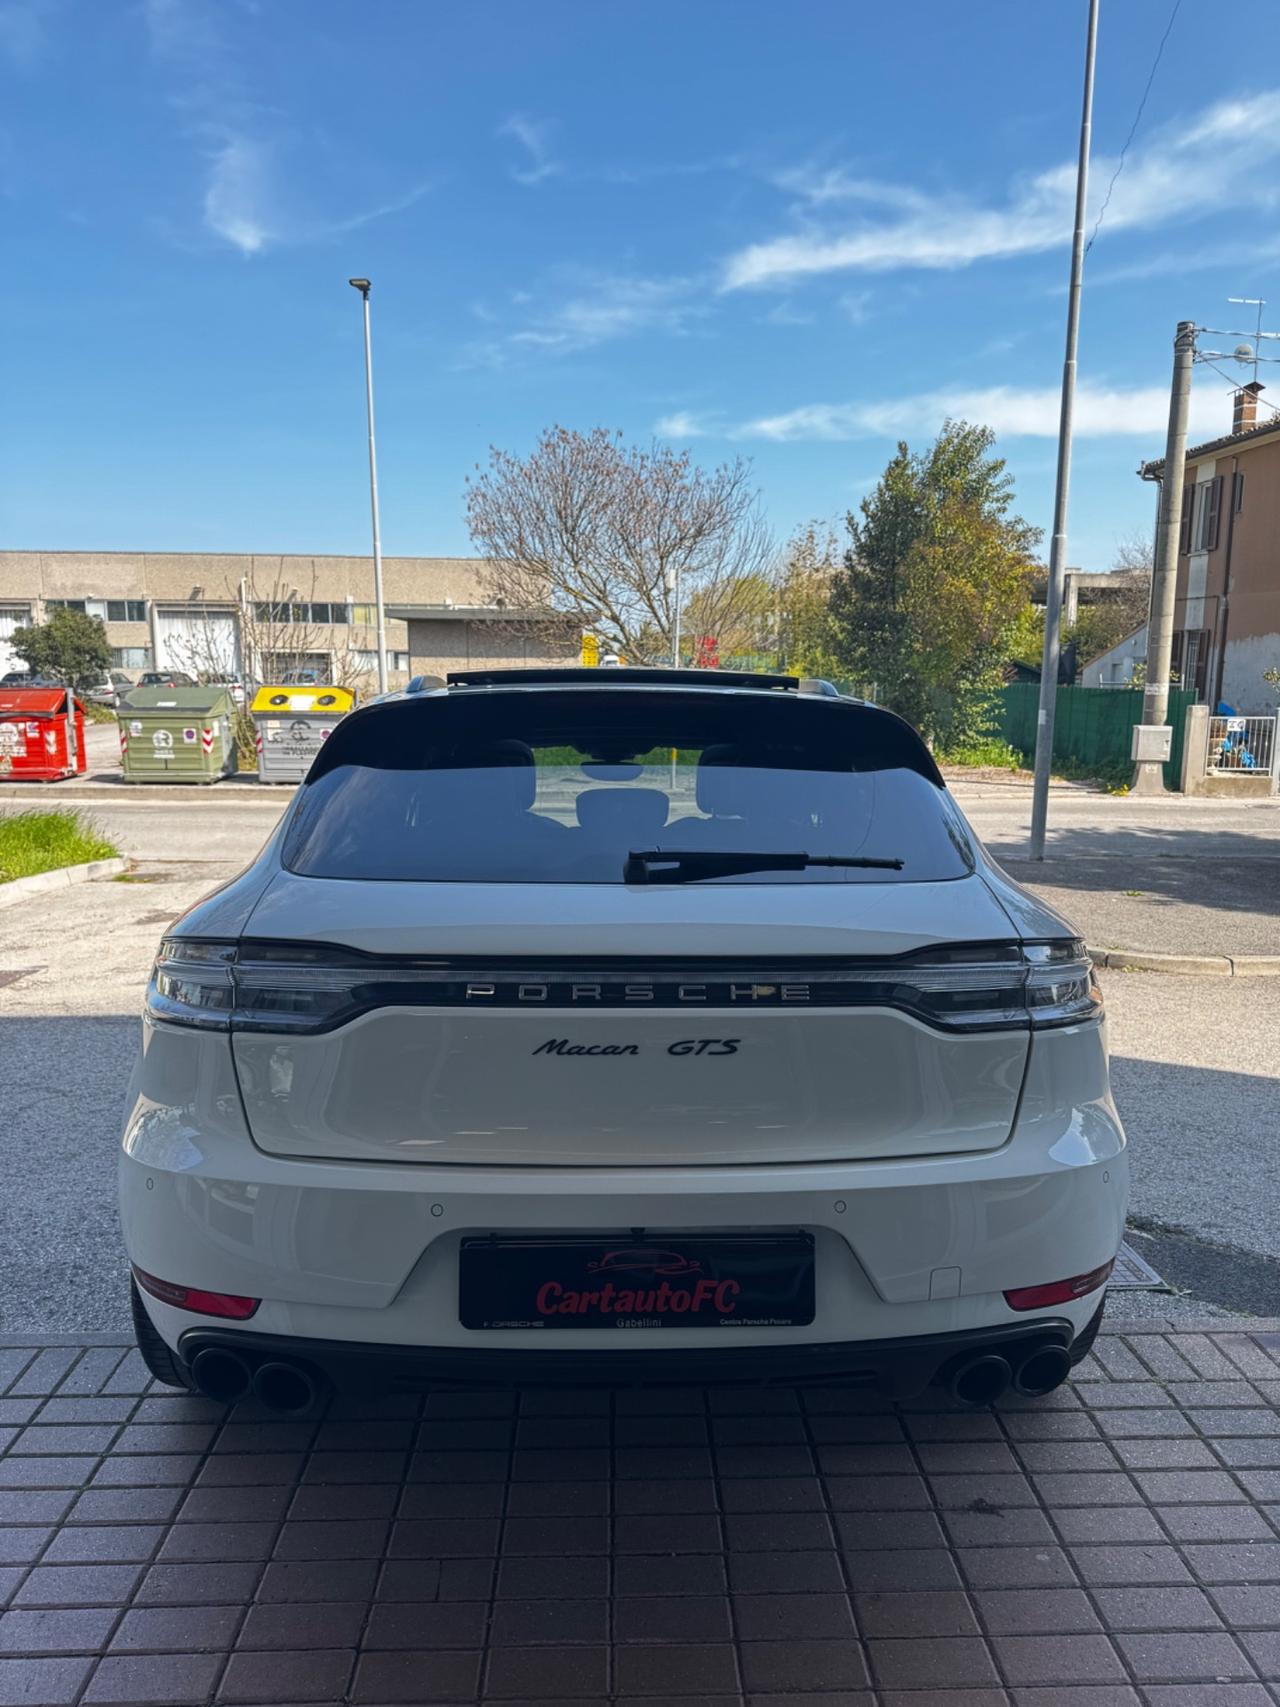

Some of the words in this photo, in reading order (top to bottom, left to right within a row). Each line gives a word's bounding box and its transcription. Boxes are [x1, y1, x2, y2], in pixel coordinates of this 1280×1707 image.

[466, 983, 810, 1001] PORSCHE
[532, 1038, 640, 1057] Macan
[667, 1038, 742, 1057] GTS
[535, 1278, 741, 1316] CartautoFC
[616, 1317, 662, 1328] Gabellini
